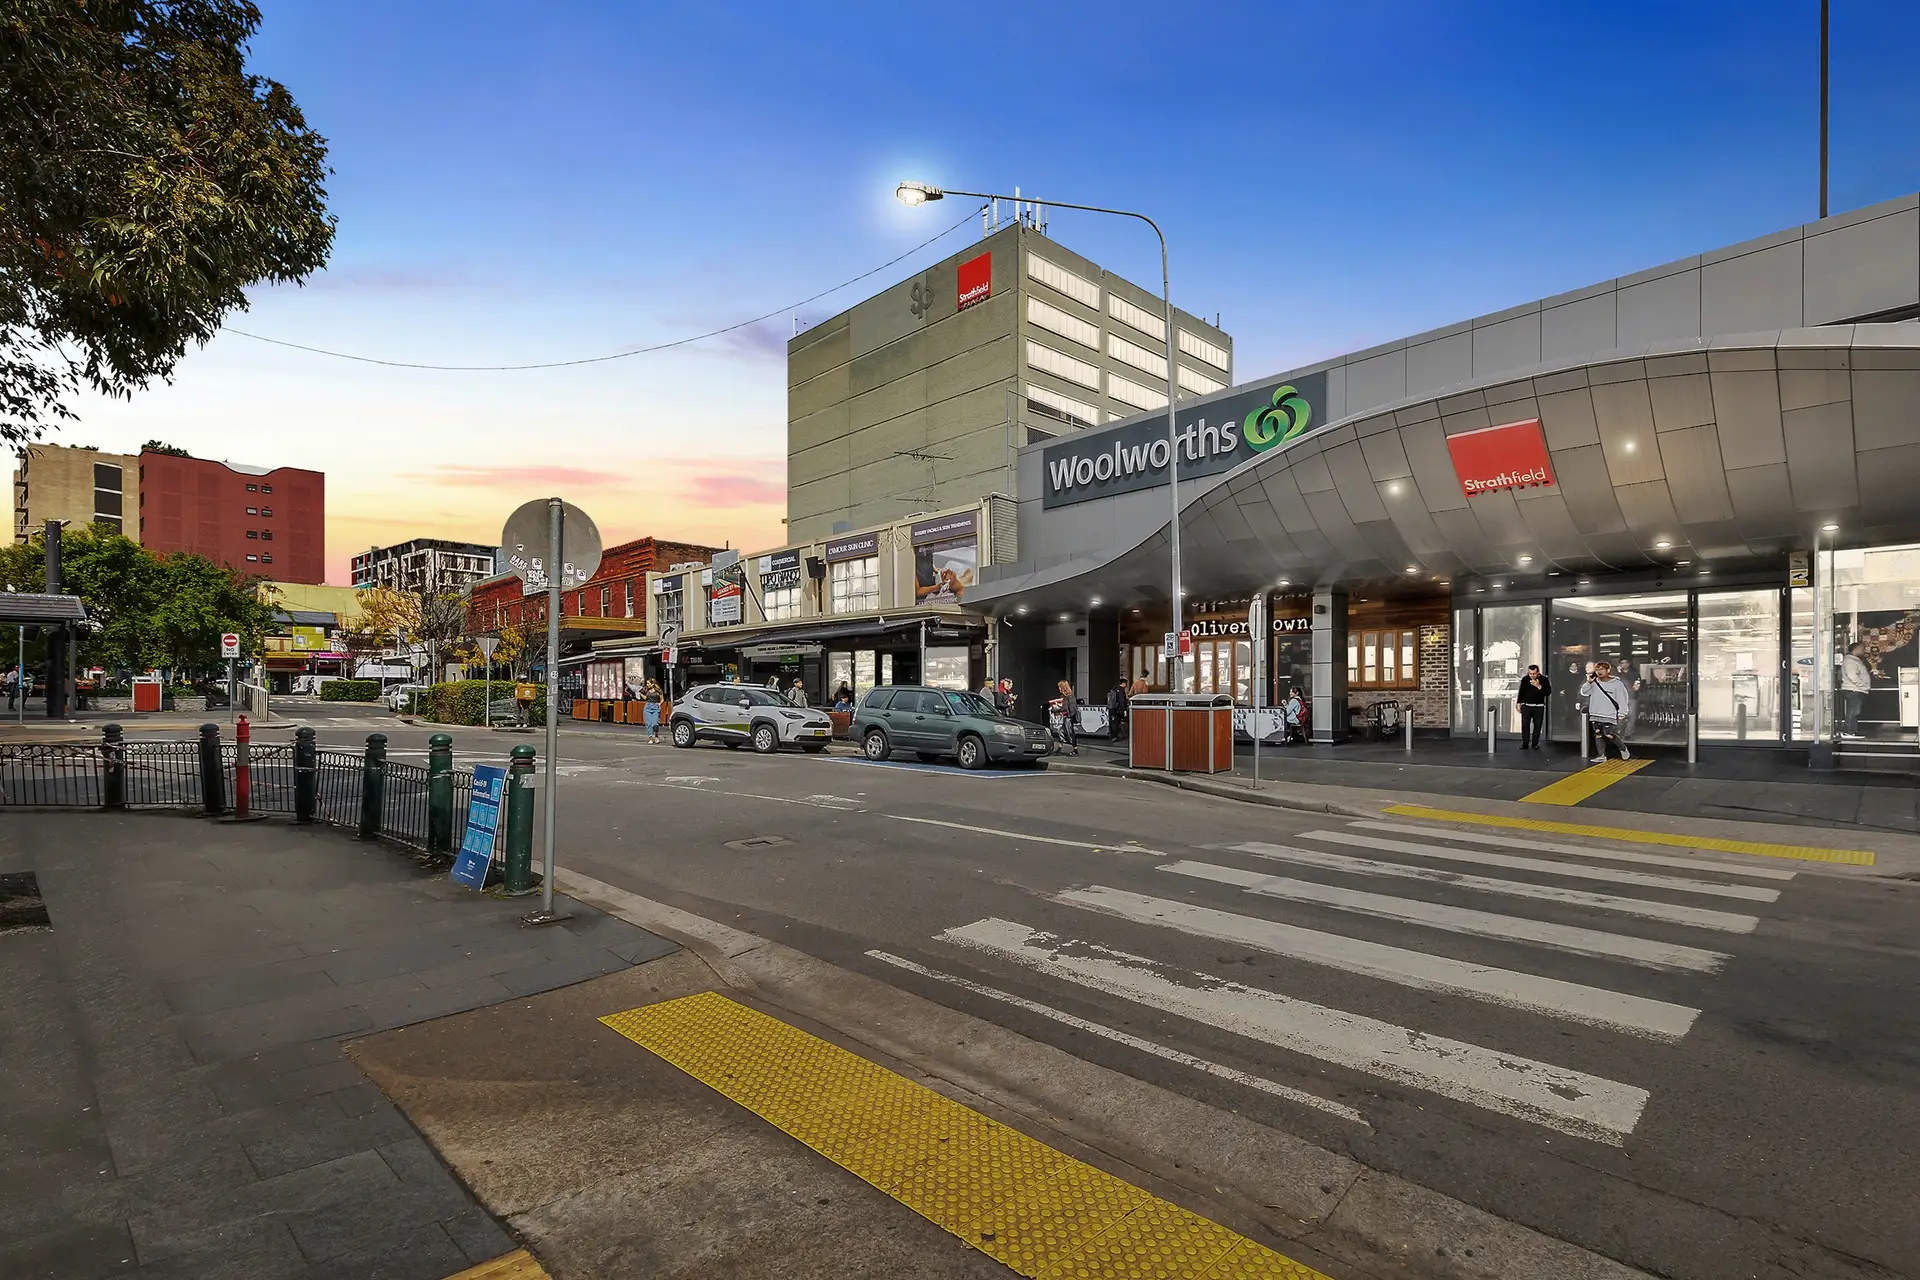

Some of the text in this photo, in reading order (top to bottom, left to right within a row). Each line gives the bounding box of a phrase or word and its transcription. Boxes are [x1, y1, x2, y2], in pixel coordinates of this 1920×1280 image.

[959, 281, 989, 303] Strathfield
[1049, 418, 1238, 491] Woolworths
[1464, 466, 1547, 491] Strathfield
[848, 542, 858, 552] SKIN
[858, 539, 874, 550] CLINIC
[1191, 618, 1314, 637] Oliver own.
